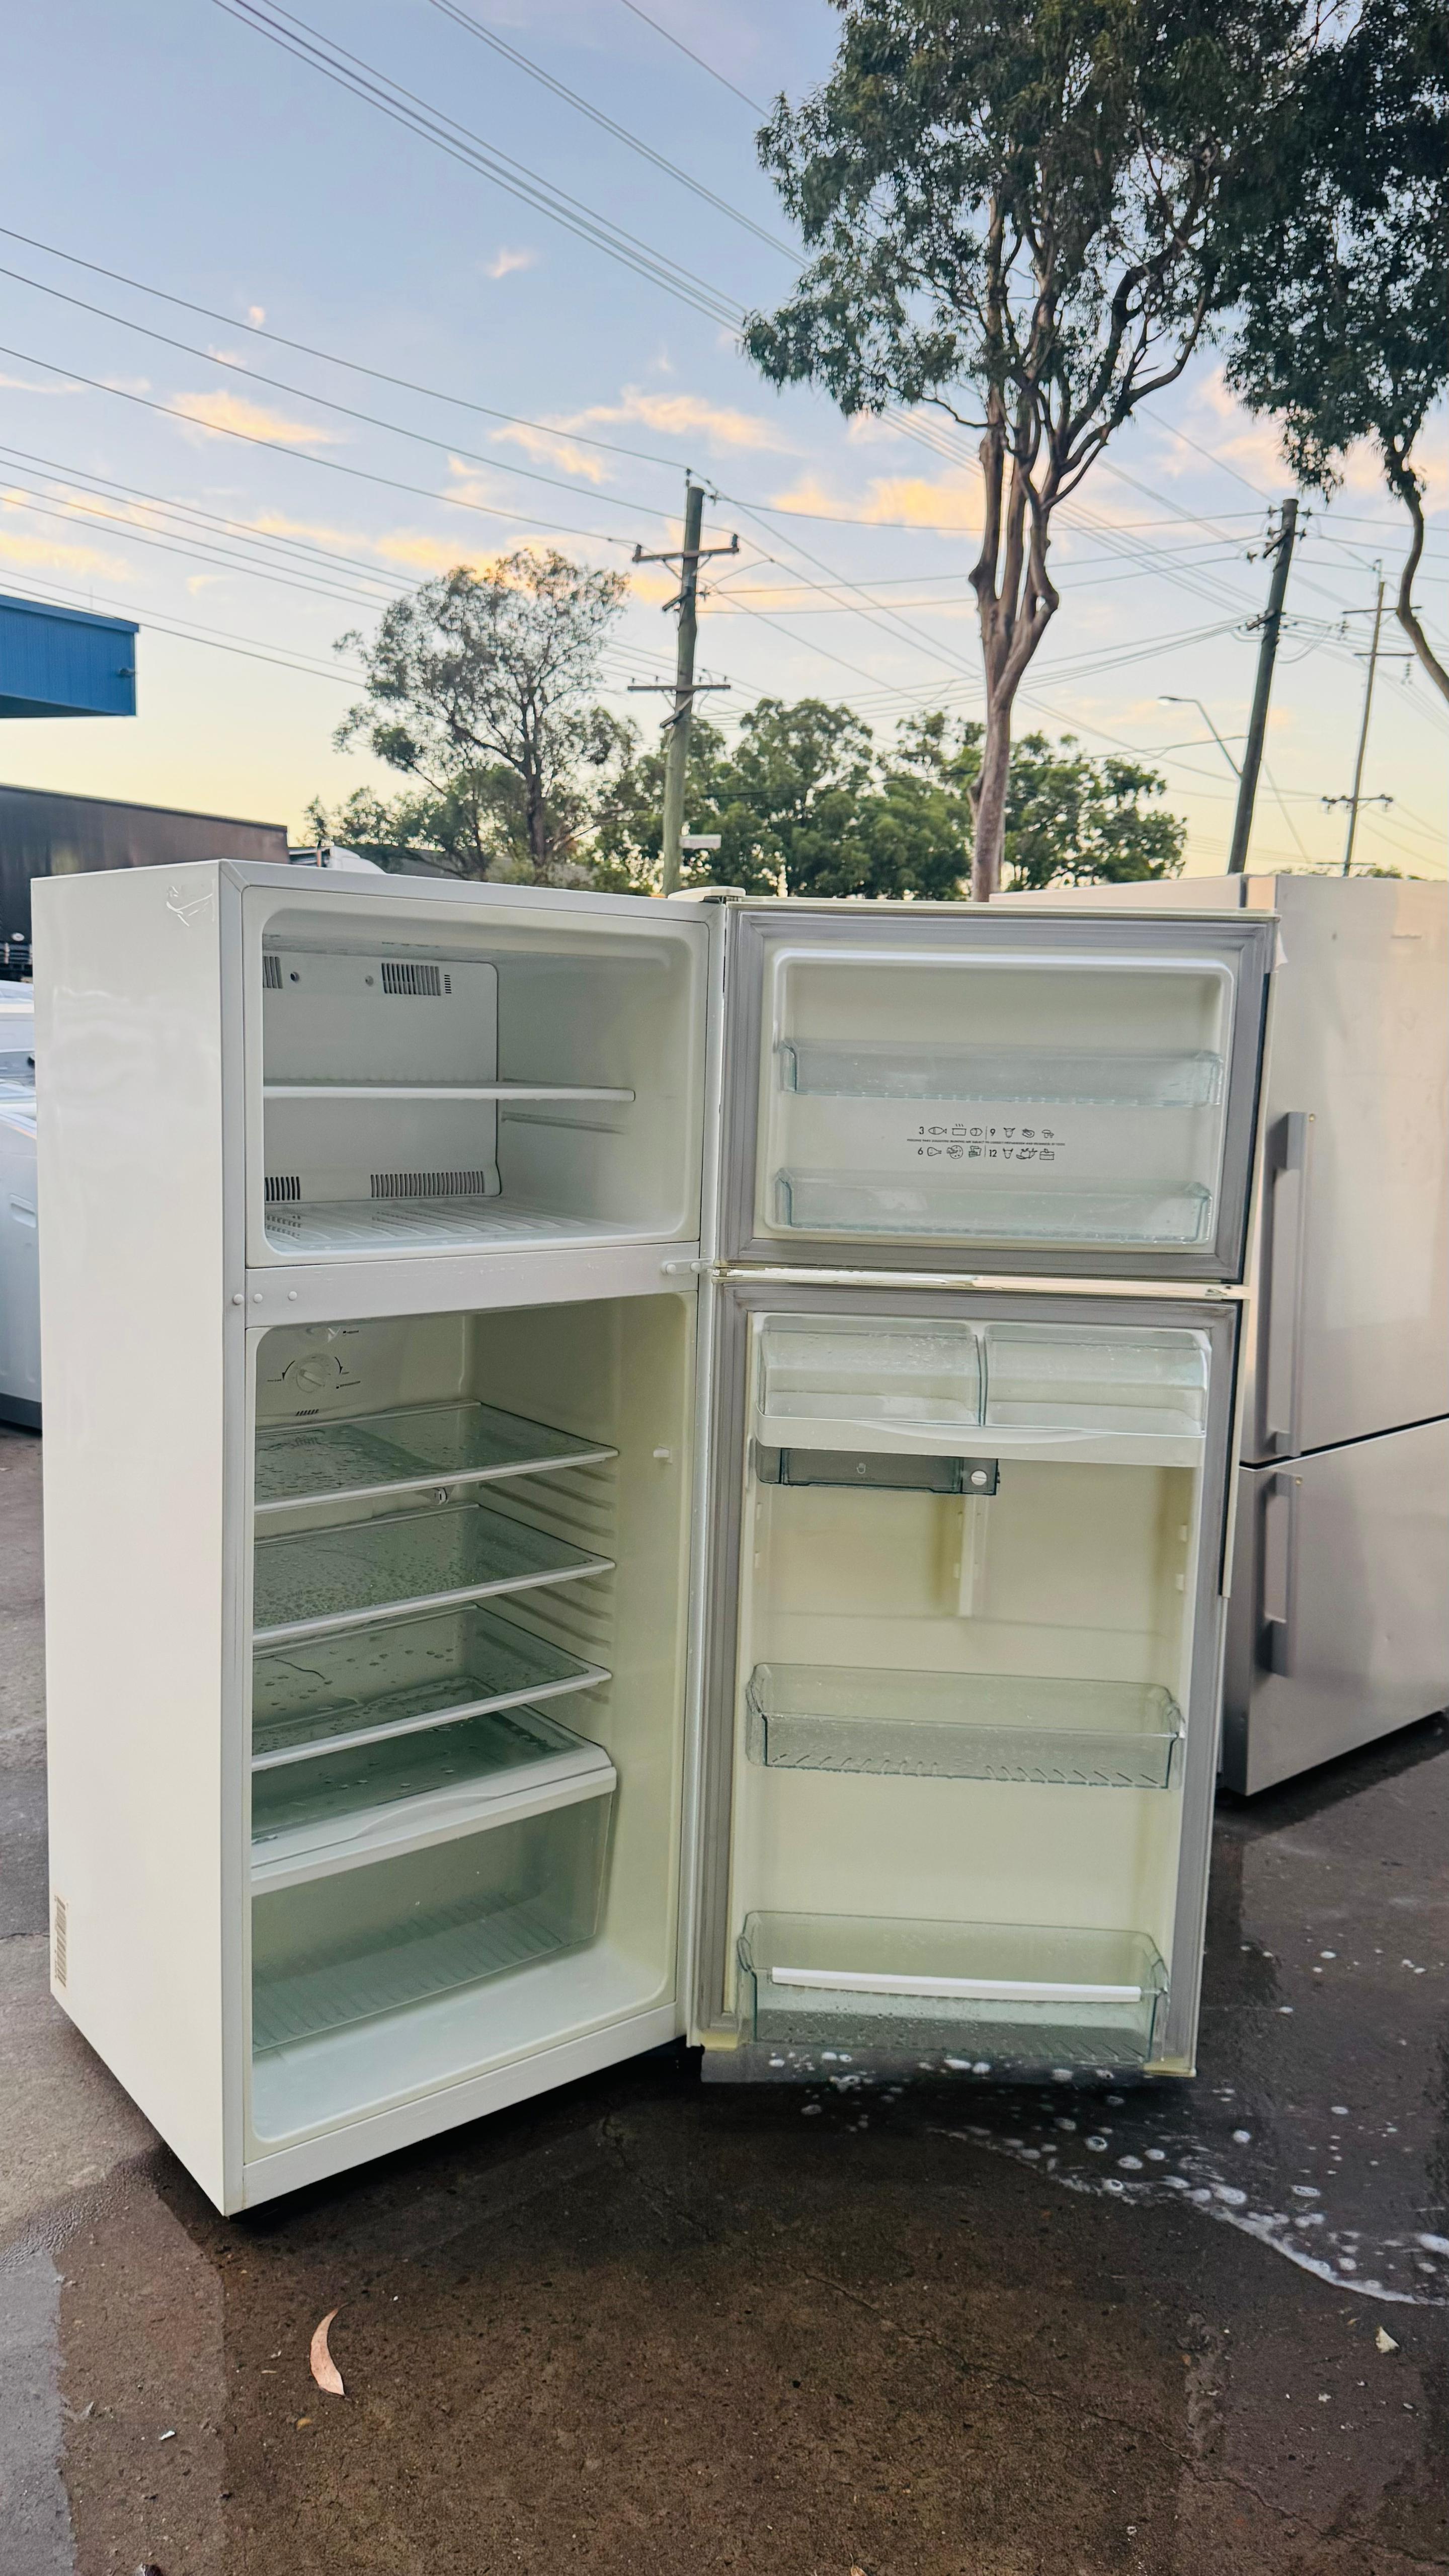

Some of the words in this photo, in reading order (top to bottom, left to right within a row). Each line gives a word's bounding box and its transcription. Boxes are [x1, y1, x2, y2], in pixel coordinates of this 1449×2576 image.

[919, 1126, 924, 1135] 3
[917, 1147, 923, 1155] 6
[990, 1149, 997, 1157] 12
